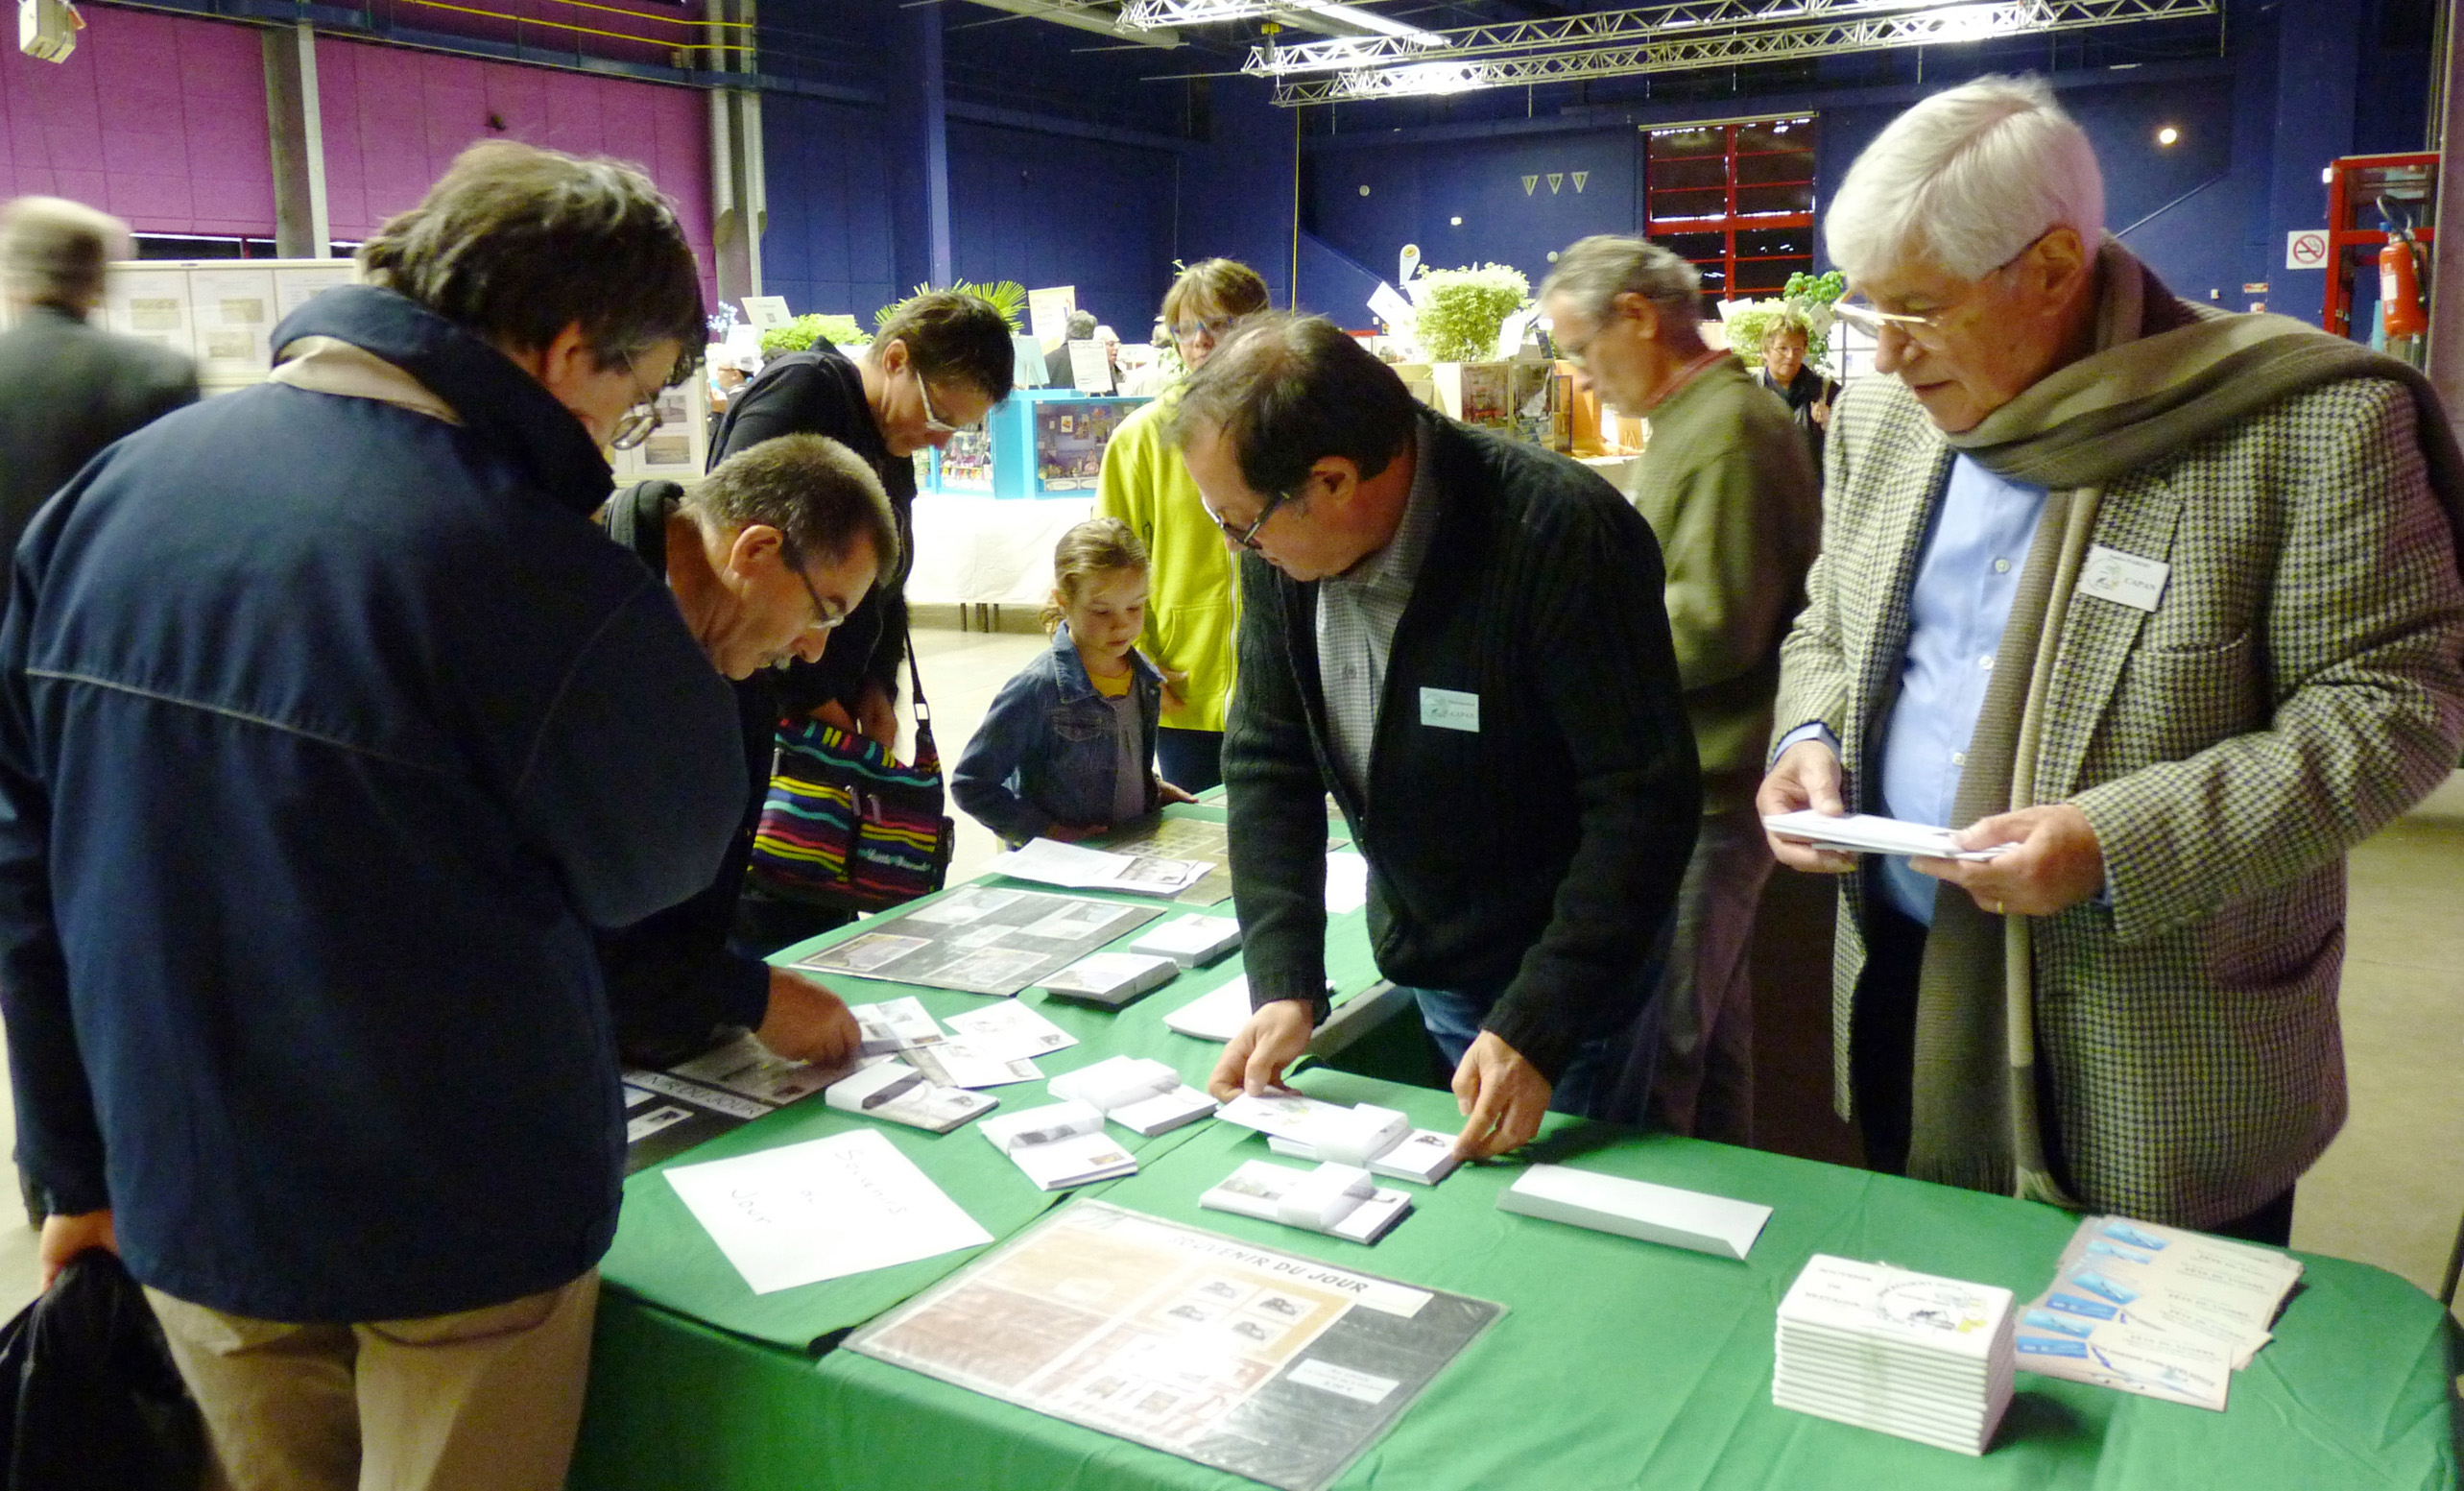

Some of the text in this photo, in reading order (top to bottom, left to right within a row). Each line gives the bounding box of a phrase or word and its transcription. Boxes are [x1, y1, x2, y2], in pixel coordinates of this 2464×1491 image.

[1168, 1235, 1370, 1294] SOUVENIR DU JOUR
